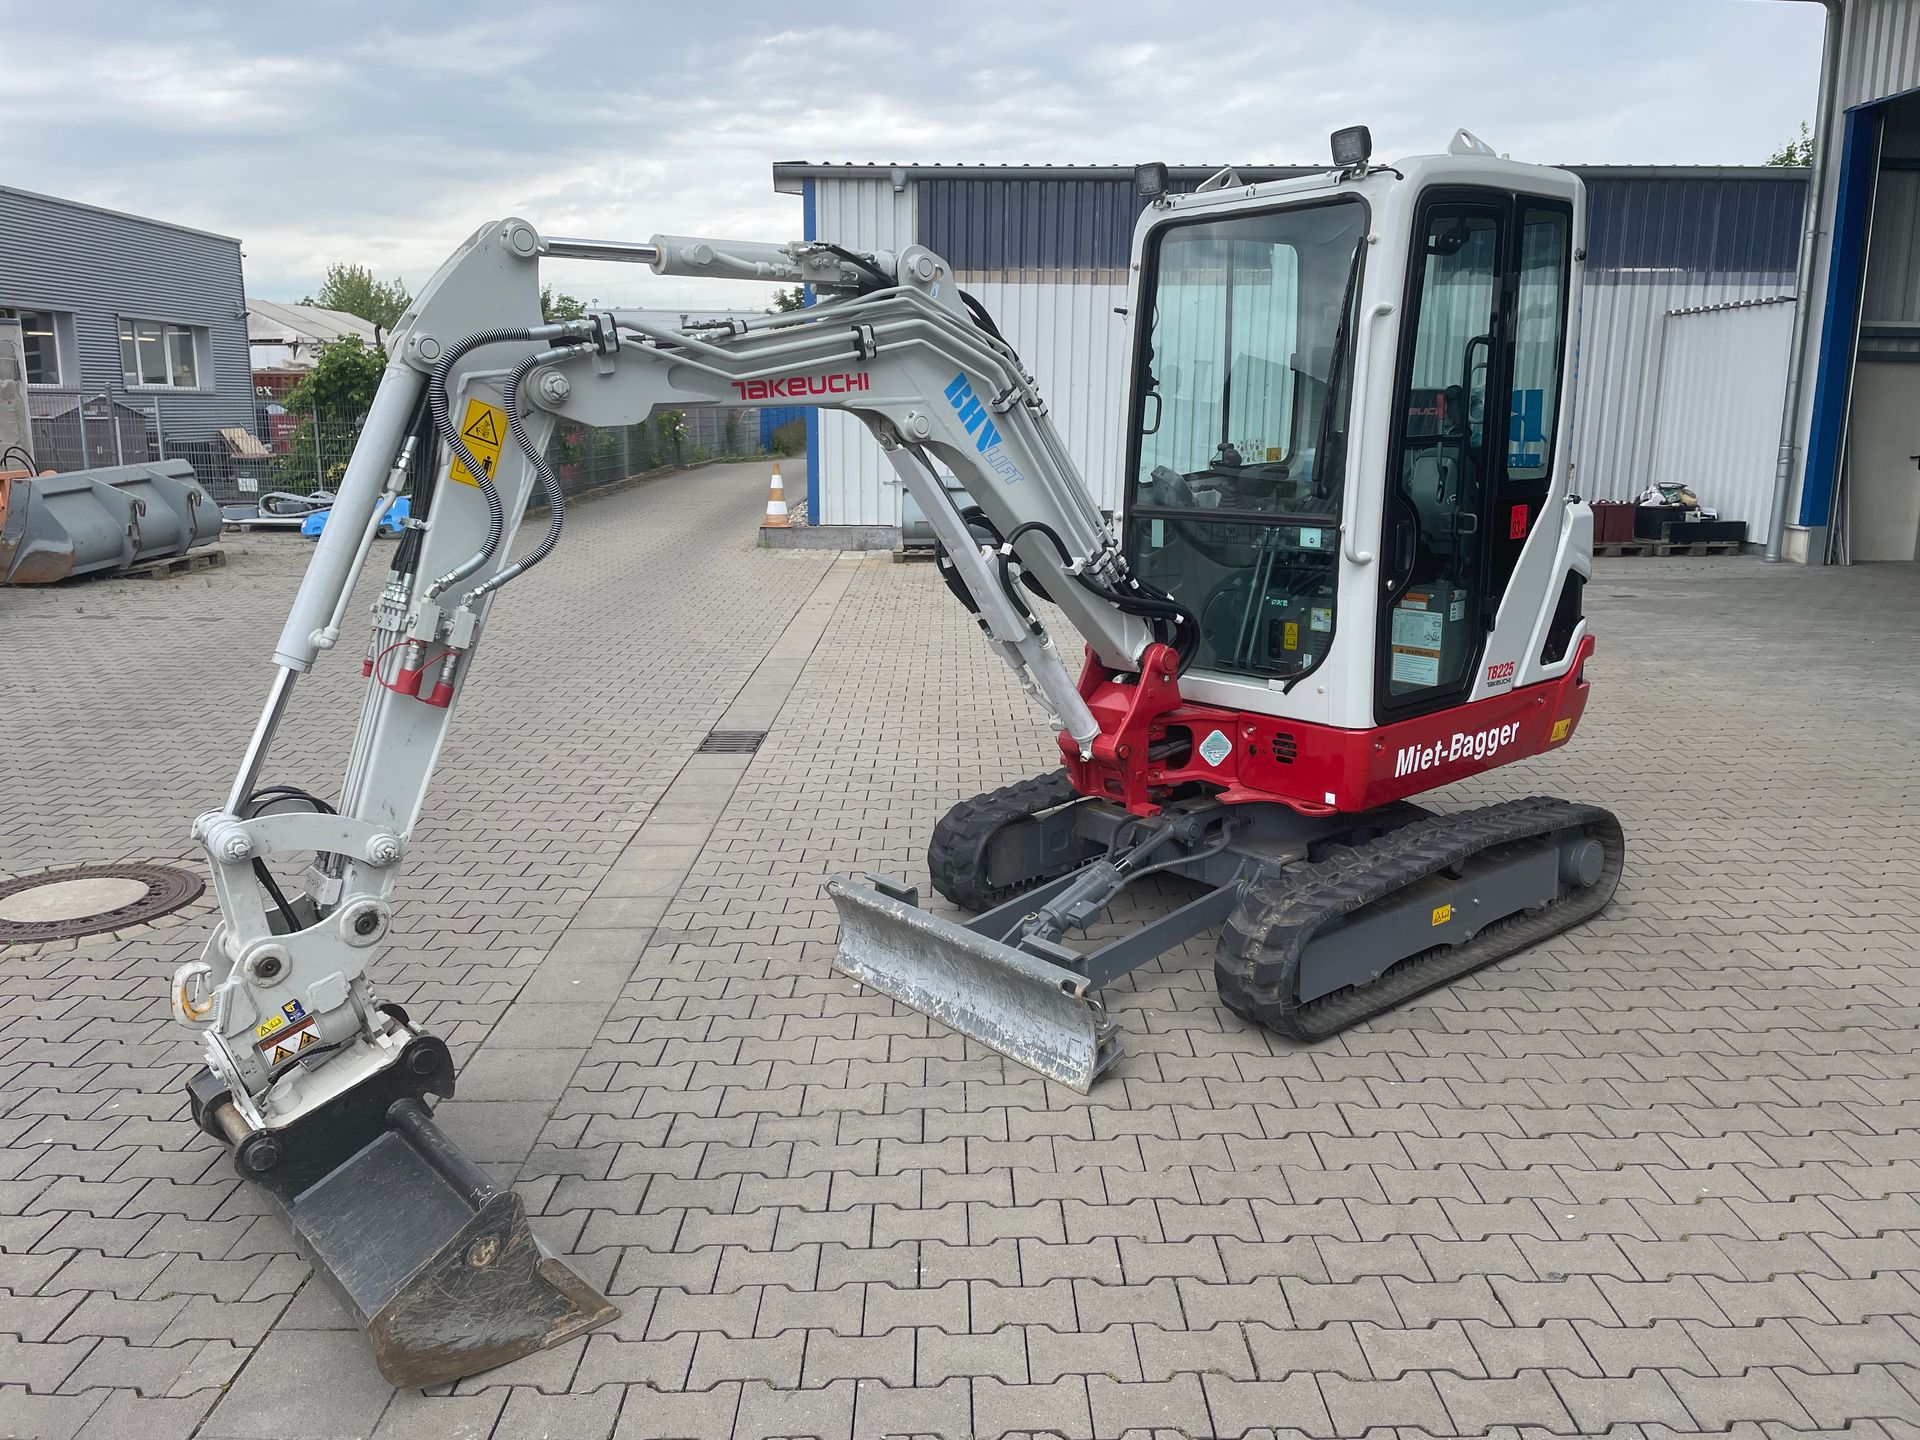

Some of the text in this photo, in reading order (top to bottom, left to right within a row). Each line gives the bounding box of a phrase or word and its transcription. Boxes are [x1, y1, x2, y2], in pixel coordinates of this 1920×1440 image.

[731, 372, 870, 400] TAKEUCHI
[943, 371, 1025, 486] BHV LIFT
[1487, 661, 1515, 680] TB225
[1394, 721, 1520, 778] Miet-Bagger
